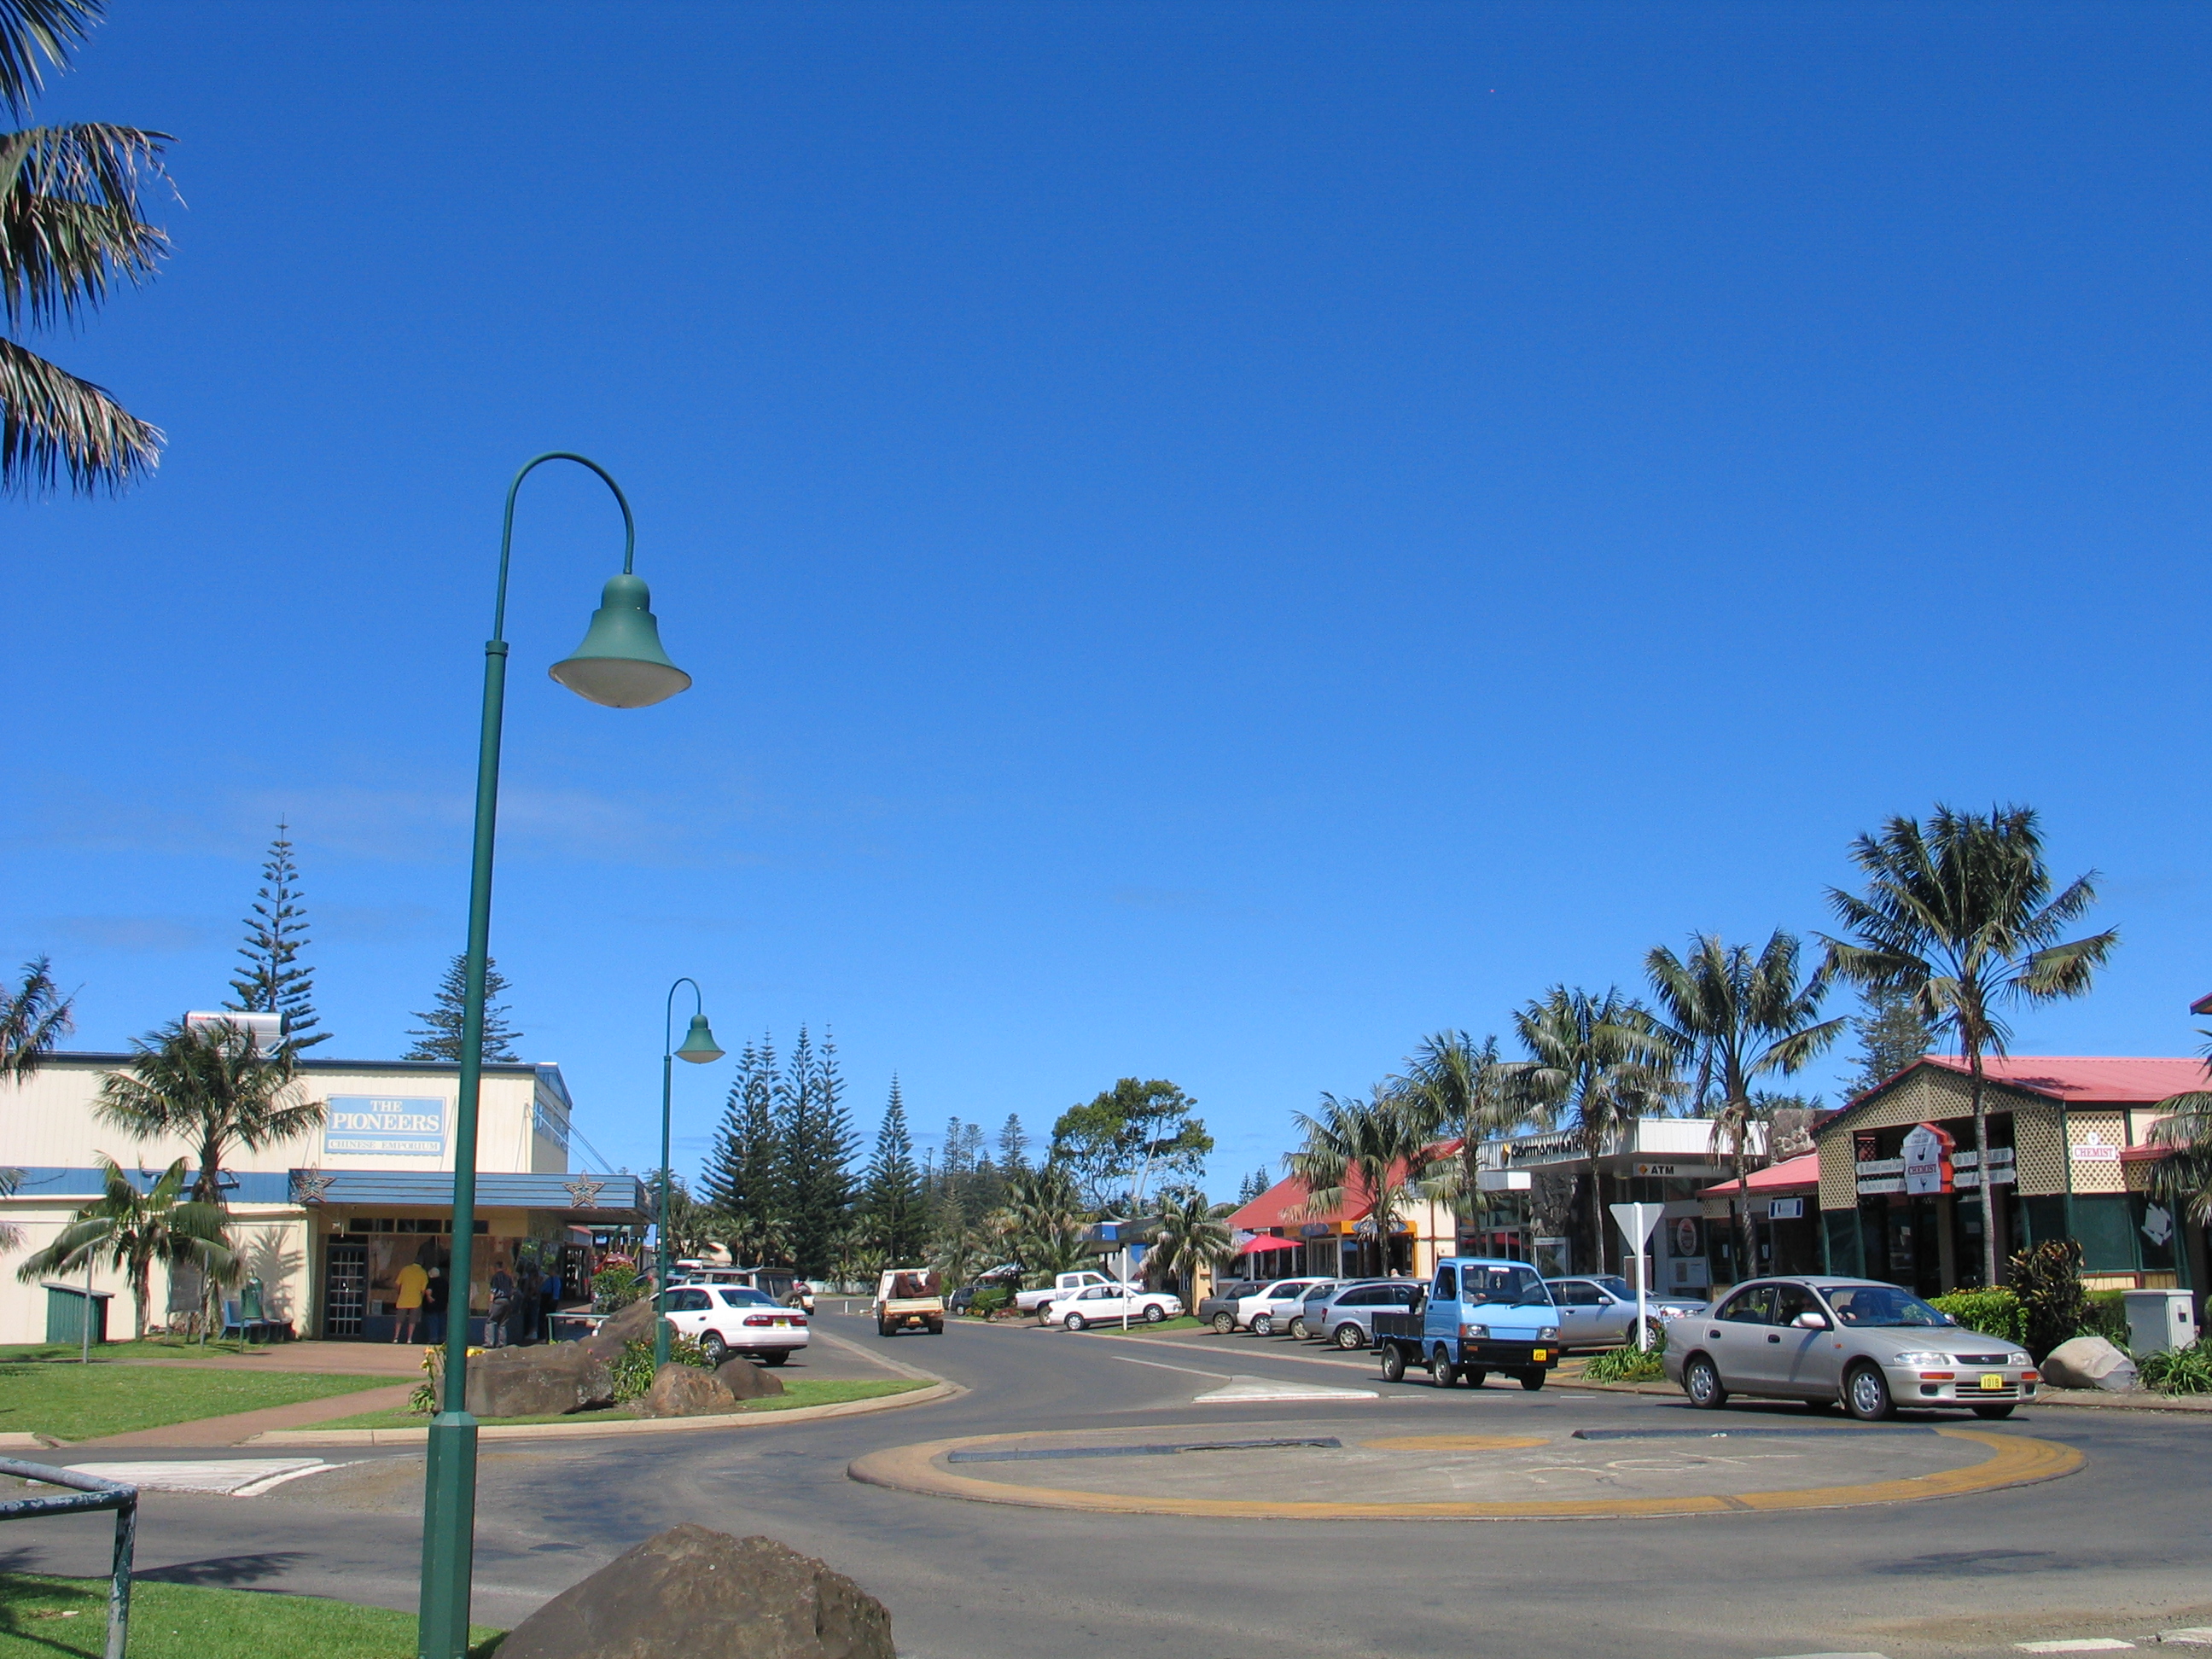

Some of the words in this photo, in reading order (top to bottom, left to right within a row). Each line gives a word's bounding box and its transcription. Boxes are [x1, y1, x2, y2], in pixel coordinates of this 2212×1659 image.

[370, 1100, 403, 1112] THE
[331, 1112, 439, 1132] PIONEERS
[330, 1140, 375, 1149] CHINESE
[381, 1141, 438, 1150] EMPORIUM
[2074, 1147, 2113, 1157] CHEMIST
[1651, 1165, 1674, 1175] ATM
[1908, 1164, 1936, 1175] CHEMIST
